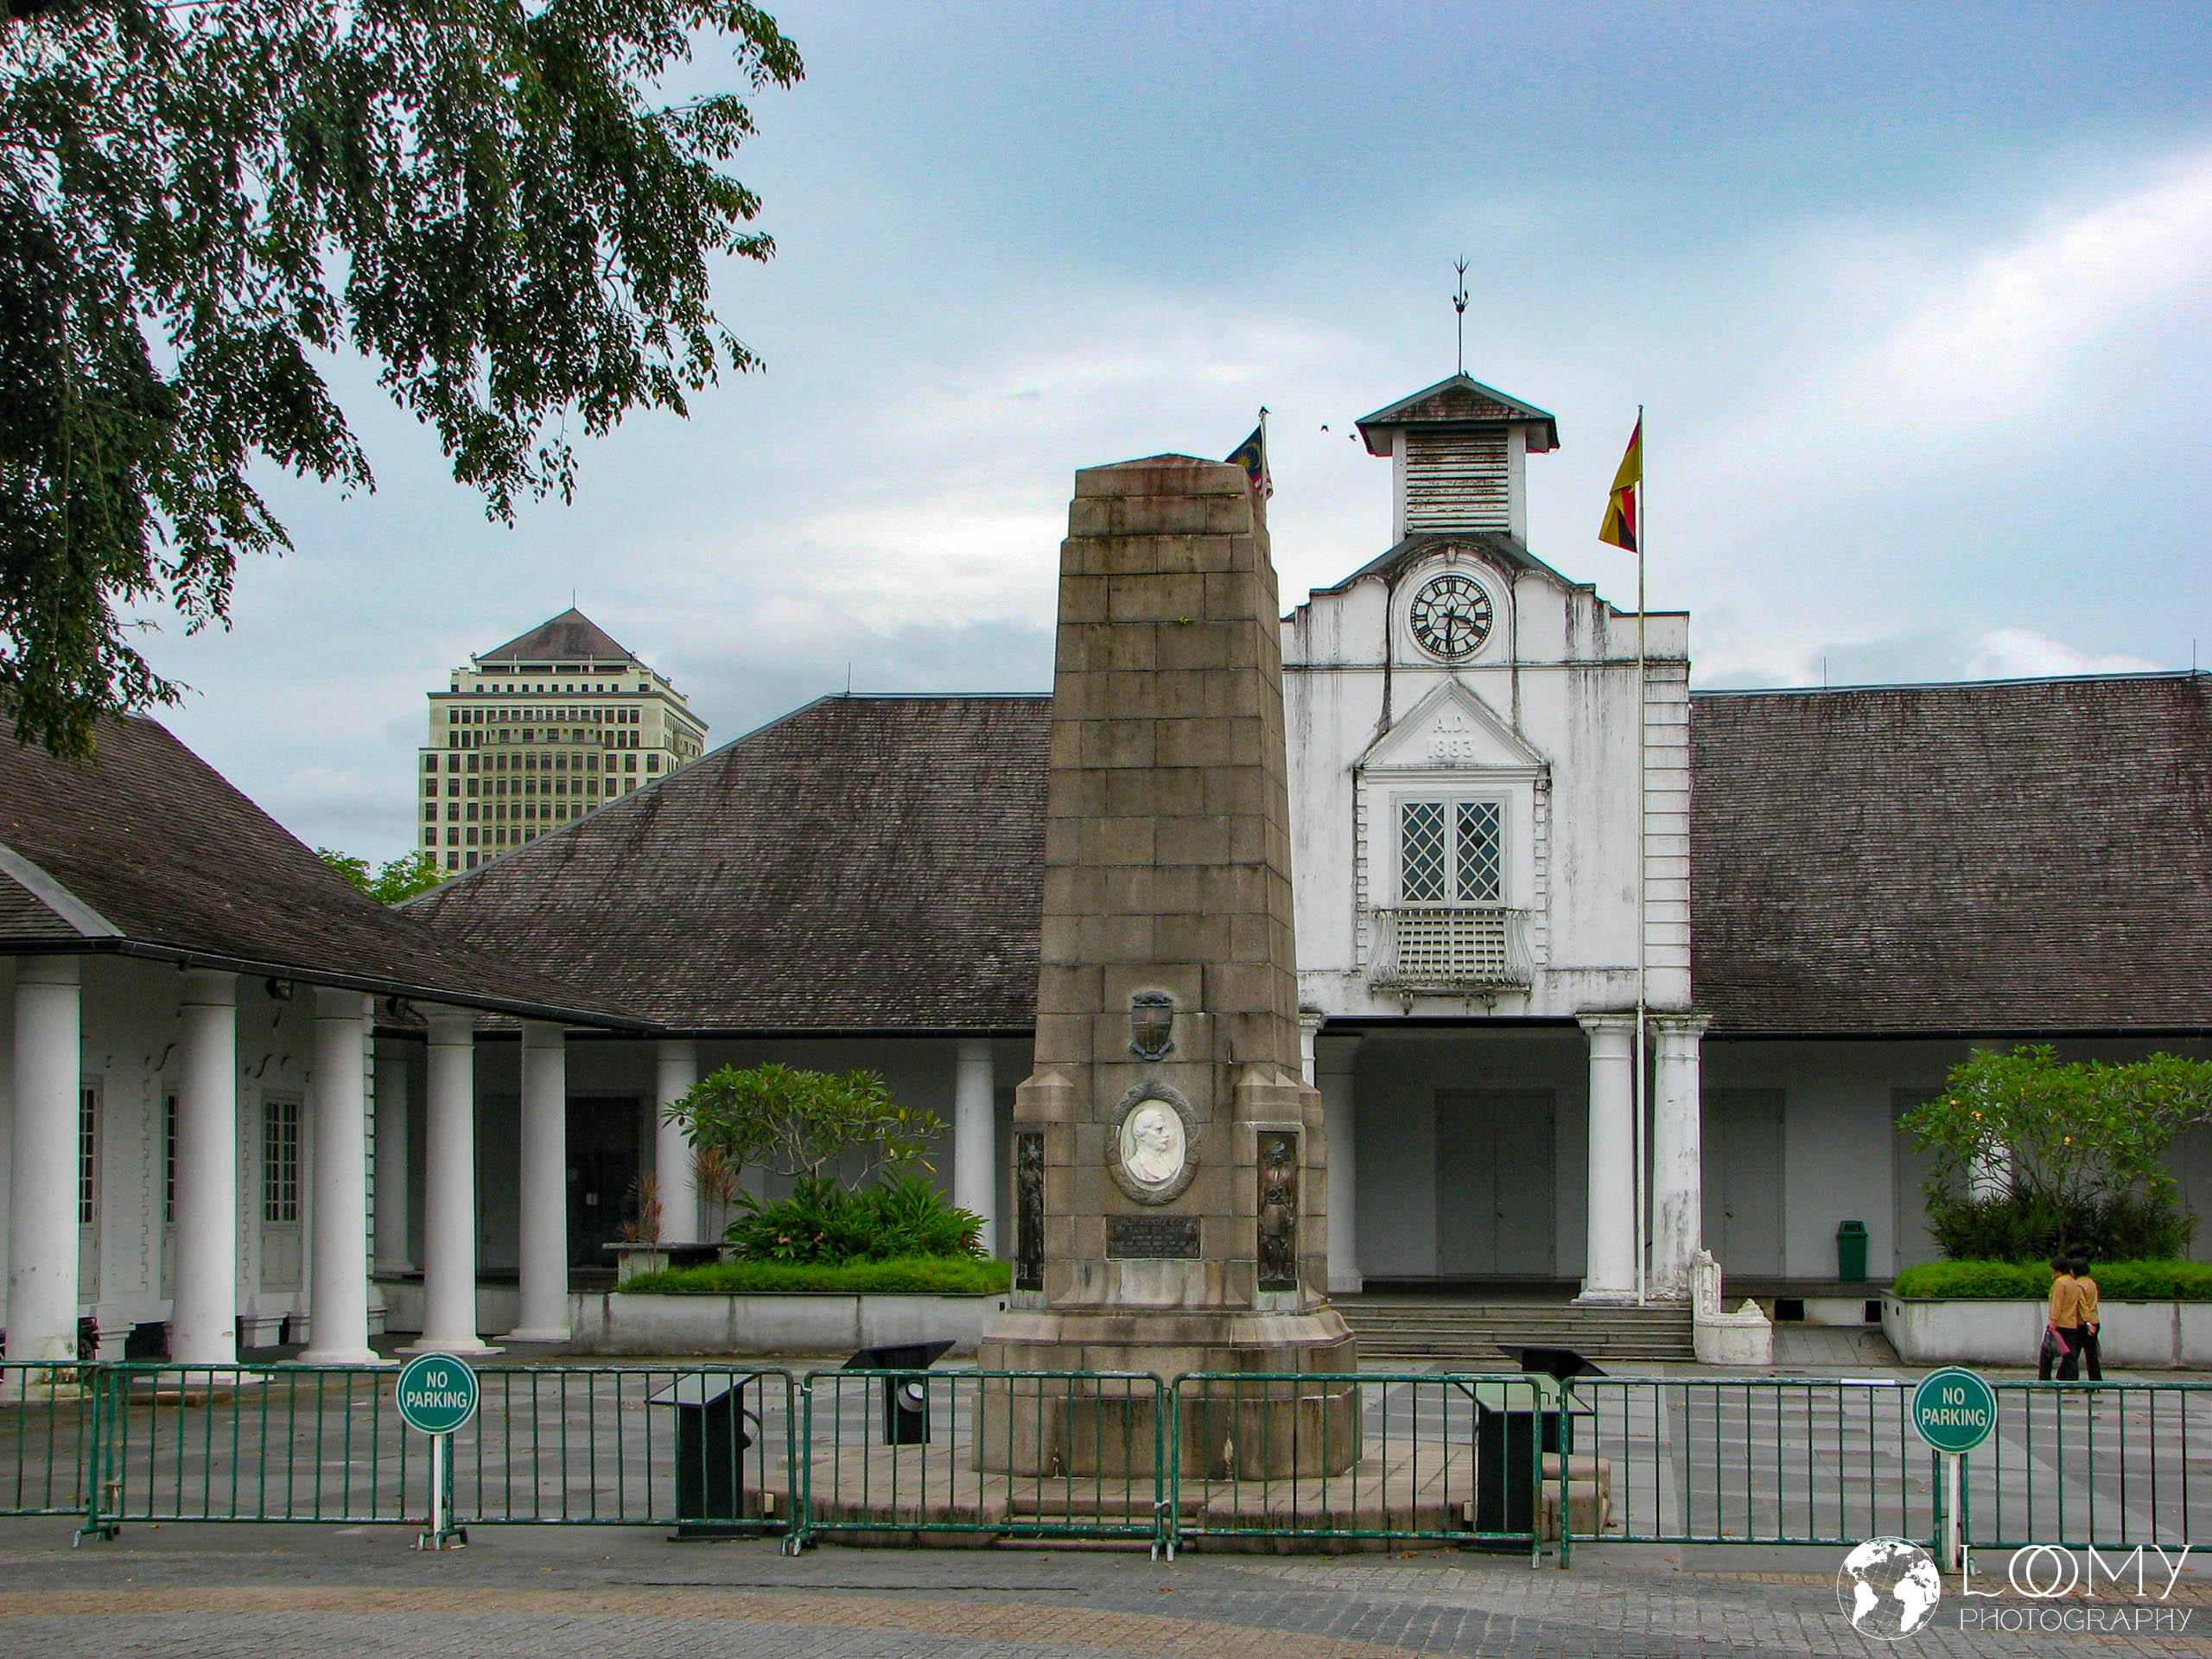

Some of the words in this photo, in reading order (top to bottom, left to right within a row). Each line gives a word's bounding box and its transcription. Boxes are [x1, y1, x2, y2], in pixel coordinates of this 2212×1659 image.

[1433, 715, 1470, 734] A.D.
[1426, 738, 1473, 759] 1883
[426, 1370, 448, 1389] NO
[406, 1390, 467, 1408] PARKING
[1942, 1387, 1965, 1405] NO
[1922, 1408, 1986, 1427] PARKING
